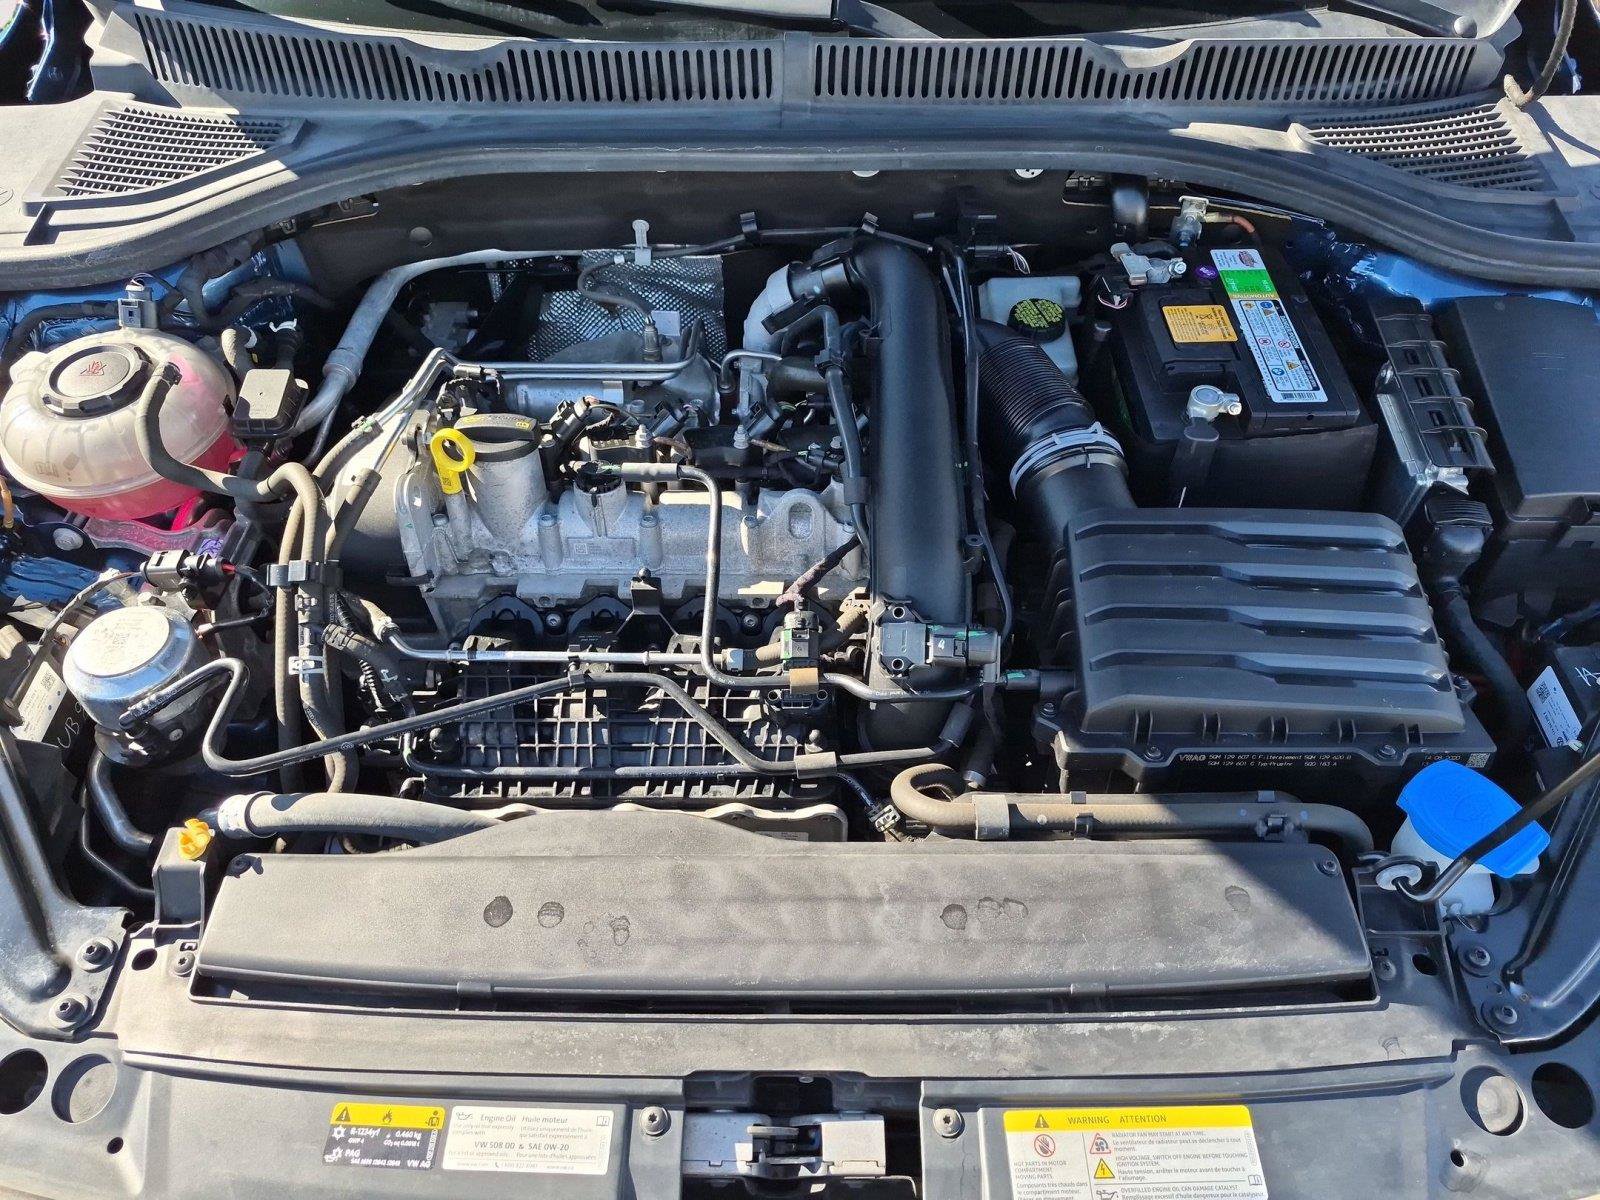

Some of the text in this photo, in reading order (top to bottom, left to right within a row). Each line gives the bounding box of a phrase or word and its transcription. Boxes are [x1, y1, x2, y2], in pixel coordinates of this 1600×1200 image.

[480, 1114, 517, 1123] Engine Oil
[521, 1115, 541, 1123] Huile
[1067, 1115, 1110, 1124] WARNING
[1119, 1114, 1167, 1123] ATTENTION
[414, 1131, 422, 1140] kg
[474, 1141, 488, 1149] VW
[489, 1141, 504, 1149] 508
[544, 1143, 569, 1151] 0W-20
[345, 1148, 361, 1158] PAG
[407, 1159, 419, 1168] VW
